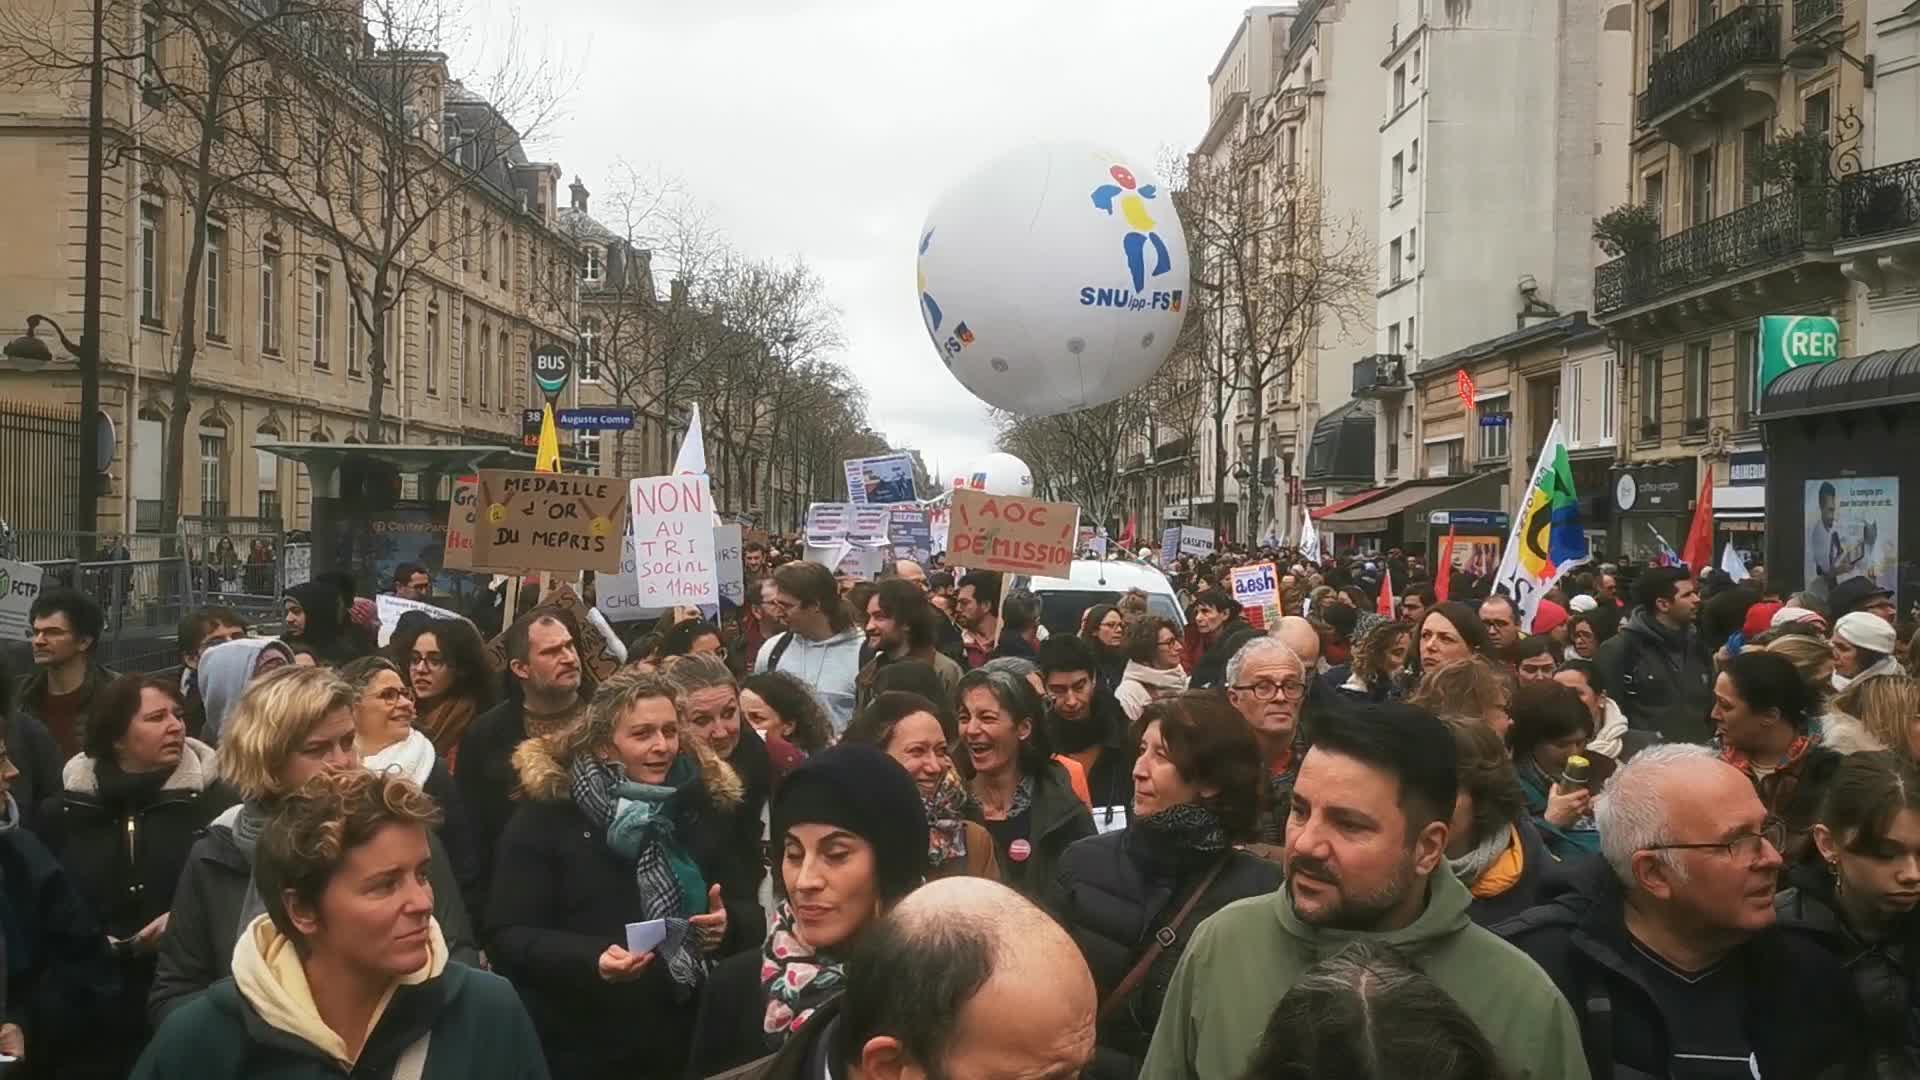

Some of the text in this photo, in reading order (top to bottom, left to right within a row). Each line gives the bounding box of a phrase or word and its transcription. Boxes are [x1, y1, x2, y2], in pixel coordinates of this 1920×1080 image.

[1792, 331, 1837, 357] RER
[538, 355, 565, 370] BUS
[527, 411, 541, 422] 38
[560, 415, 631, 425] Auguste Comte
[504, 478, 608, 498] MEDAILLE
[637, 481, 702, 515] NON
[979, 499, 1048, 527] AOC
[656, 522, 684, 537] AU
[493, 528, 607, 553] DU MEPRIS
[640, 539, 697, 557] TRI
[11, 580, 38, 598] FCTP
